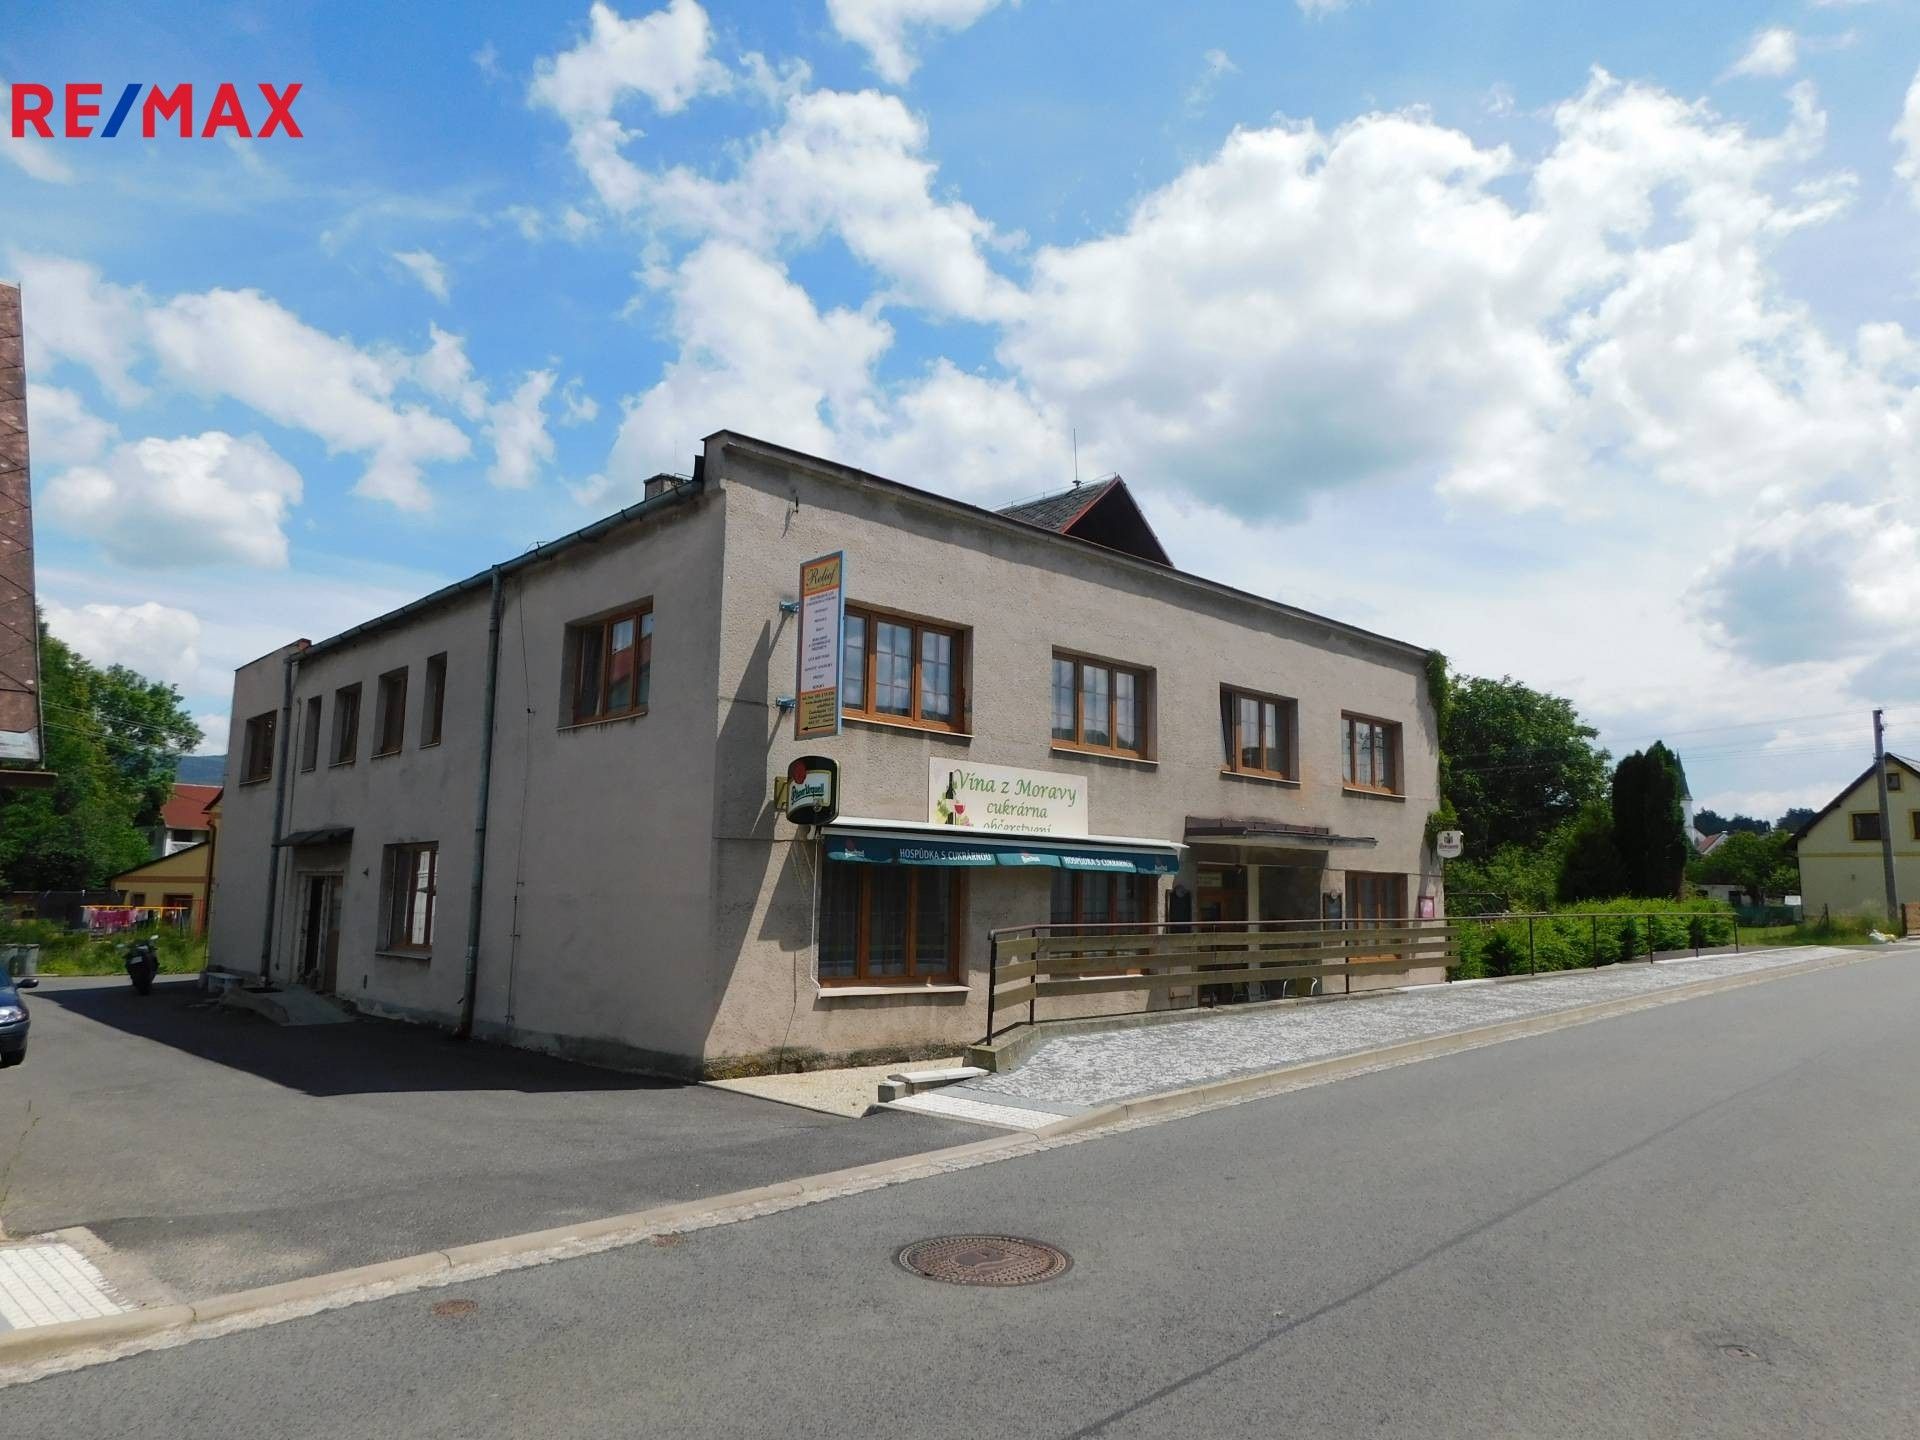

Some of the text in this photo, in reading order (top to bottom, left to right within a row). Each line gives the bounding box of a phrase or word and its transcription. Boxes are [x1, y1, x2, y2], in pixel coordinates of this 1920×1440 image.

[954, 768, 1077, 807] Vína z Moravy
[986, 799, 1049, 819] cukrárna
[900, 848, 939, 860] HOSPŮDKA
[941, 851, 946, 860] S
